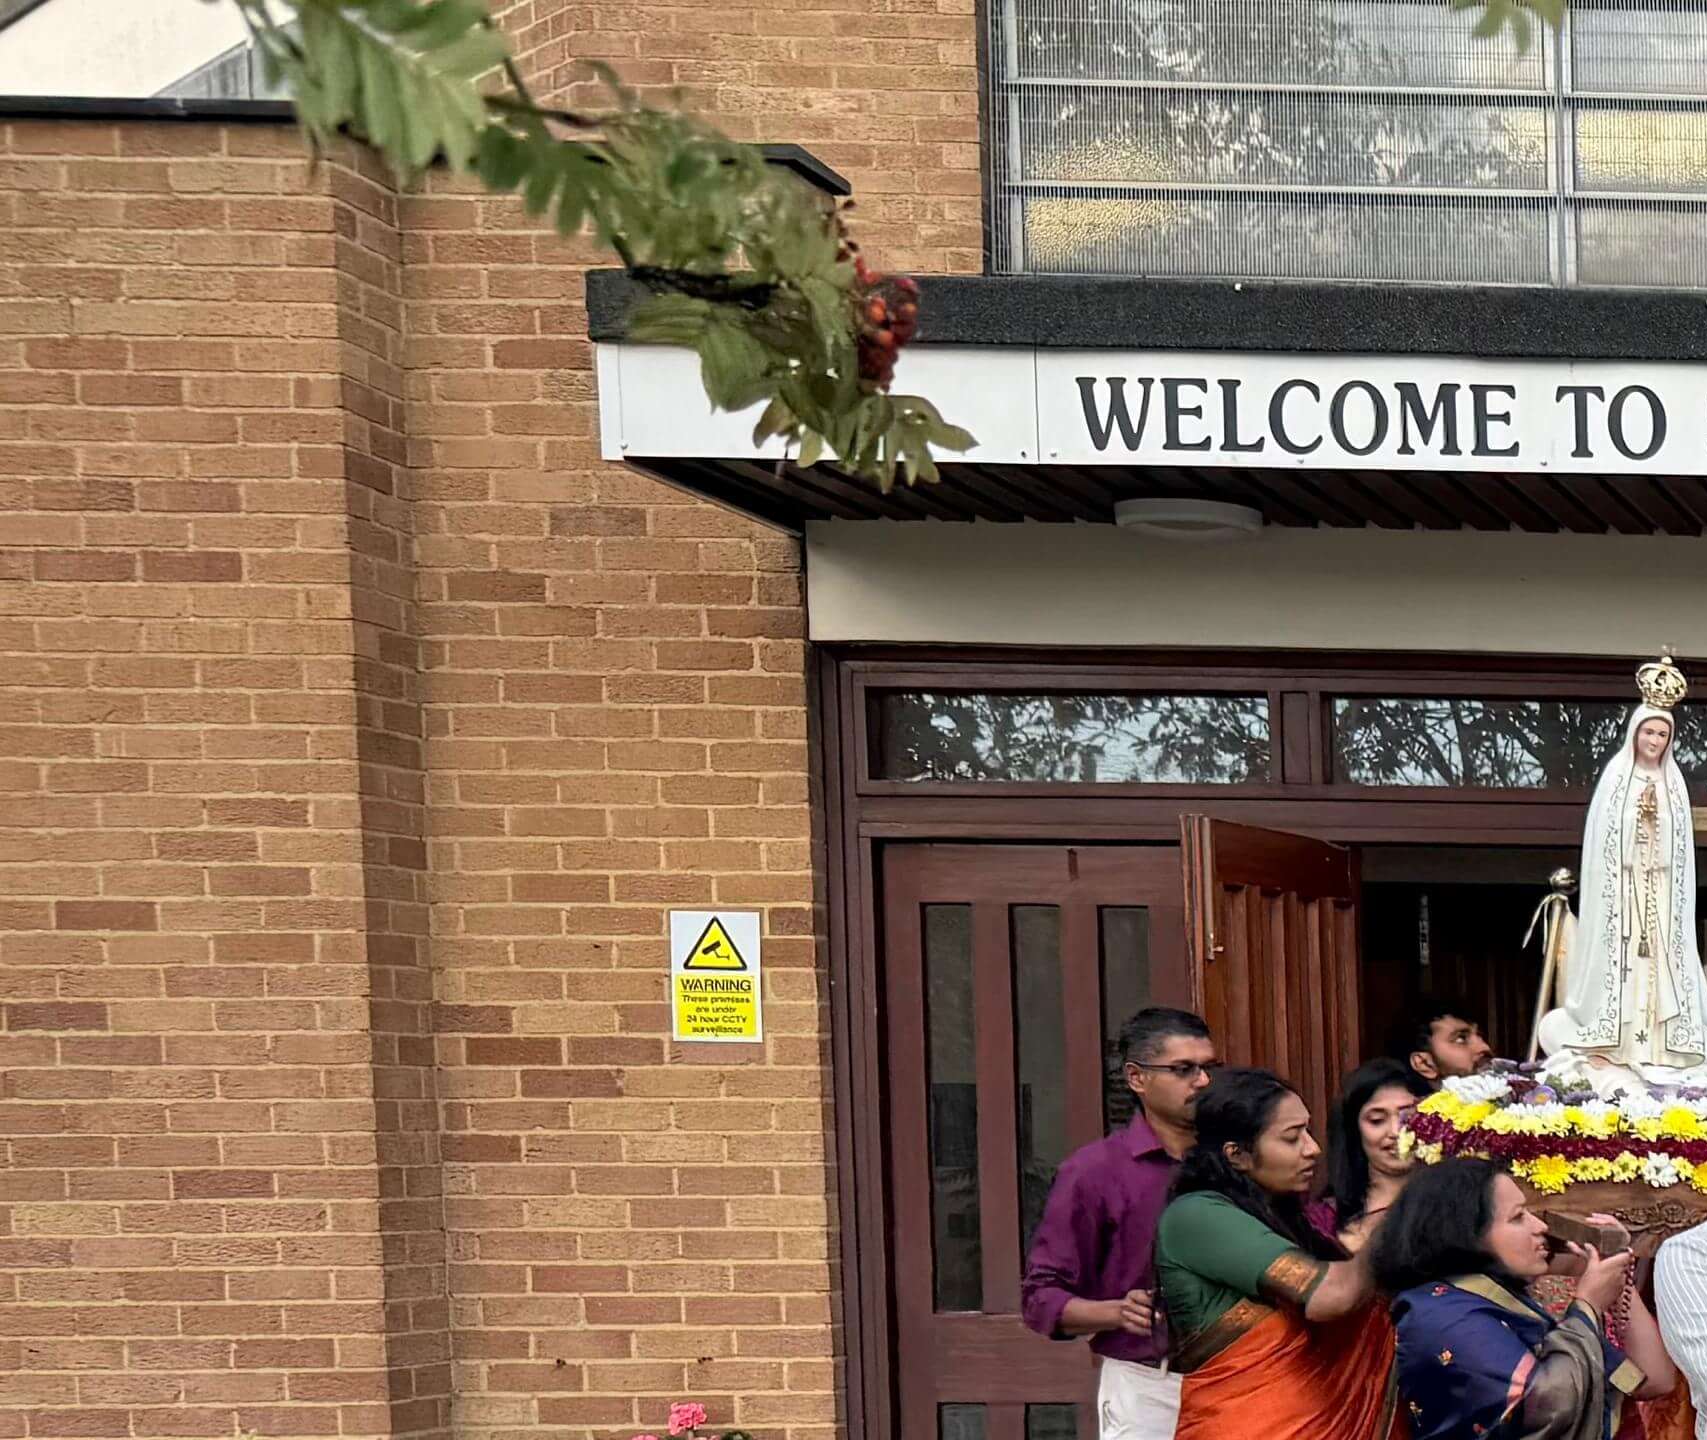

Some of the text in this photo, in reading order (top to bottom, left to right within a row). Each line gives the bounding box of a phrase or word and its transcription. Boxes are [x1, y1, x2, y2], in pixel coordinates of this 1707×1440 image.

[1075, 376, 1520, 457] WELCOME
[1555, 383, 1668, 461] TO
[680, 978, 752, 991] WARNING
[721, 1015, 748, 1023] CCTV
